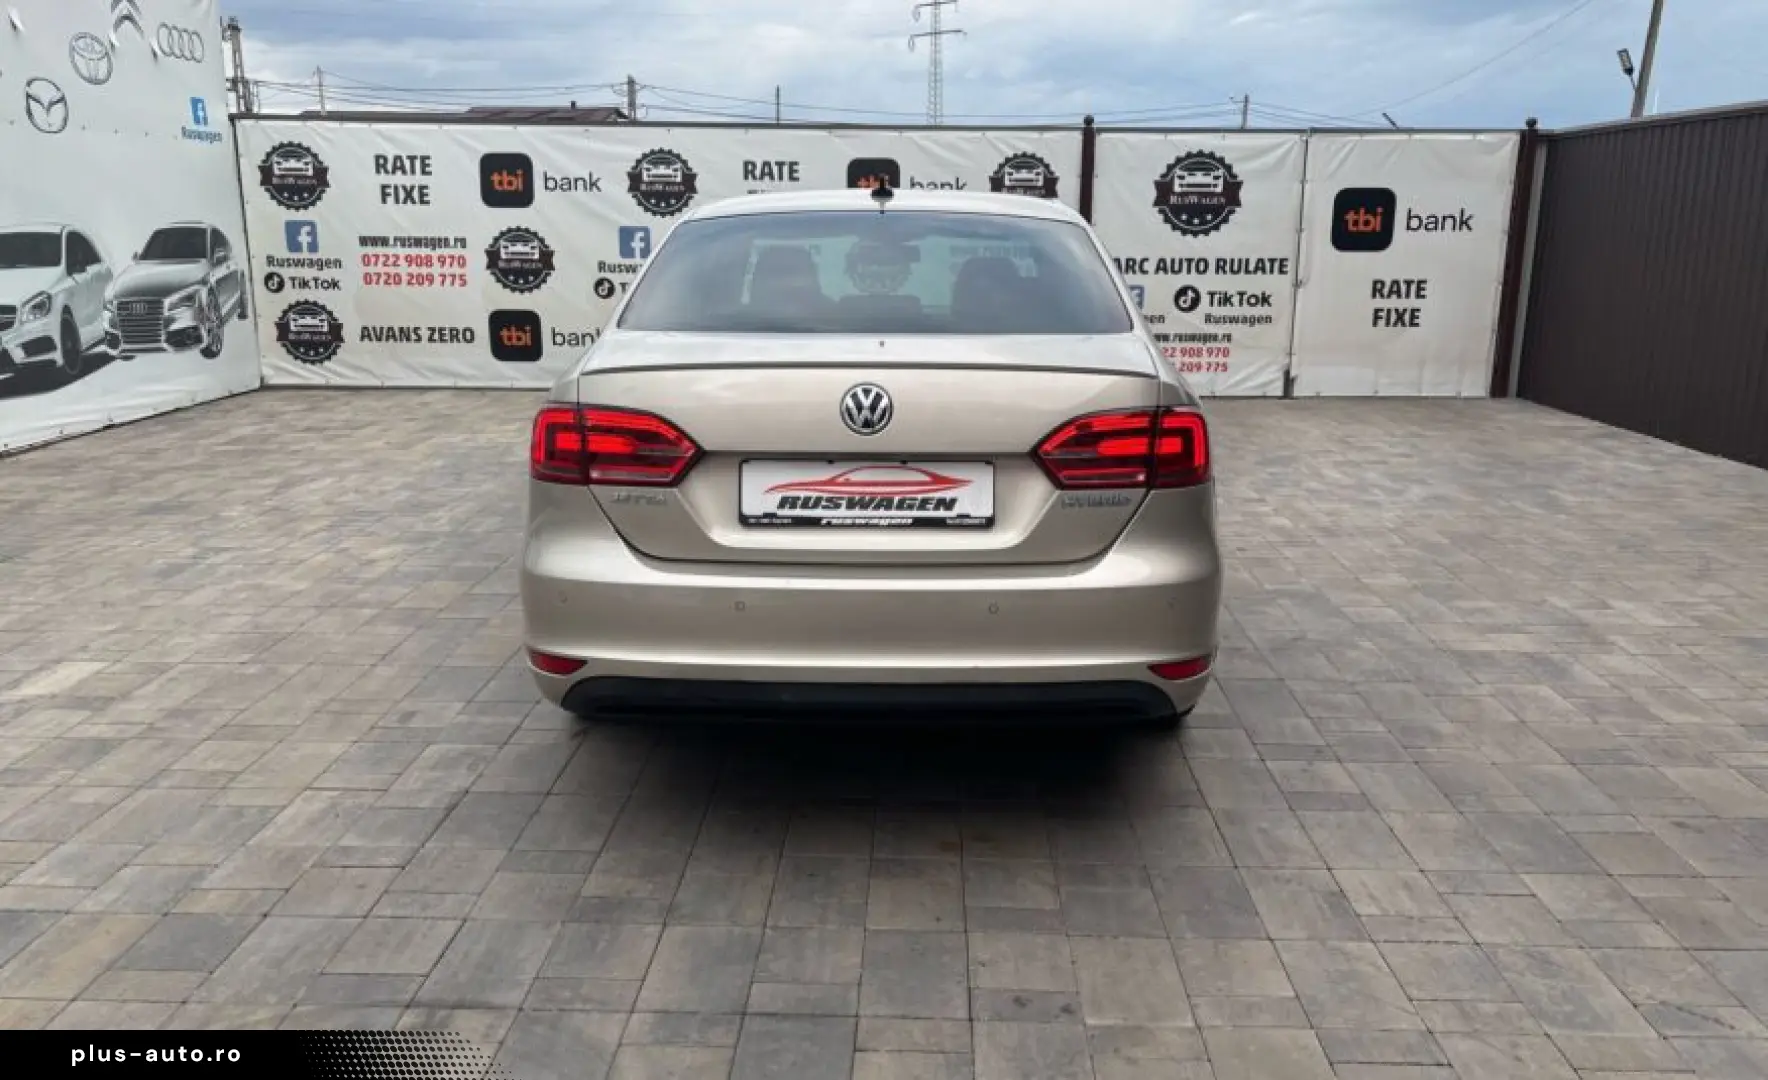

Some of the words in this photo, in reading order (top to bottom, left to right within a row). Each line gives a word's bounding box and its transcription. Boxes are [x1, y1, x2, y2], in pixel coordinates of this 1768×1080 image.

[373, 154, 432, 176] RATE
[743, 160, 800, 182] RATE
[490, 170, 524, 192] tbi
[542, 171, 602, 192] bank
[380, 184, 431, 205] FIXE
[1343, 207, 1383, 232] tbi
[1405, 208, 1474, 232] bank
[266, 255, 342, 271] Ruswagen
[361, 253, 400, 267] 0722
[403, 254, 433, 268] 908
[437, 255, 467, 269] 970
[597, 260, 639, 274] Rusw
[1112, 258, 1149, 275] ARC
[1154, 258, 1209, 275] AUTO
[1214, 258, 1289, 275] RULATE
[288, 276, 341, 291] TikTok
[363, 272, 402, 286] 0720
[406, 273, 434, 287] 209
[438, 274, 468, 288] 775
[1370, 279, 1428, 300] RATE
[1206, 290, 1273, 308] TikTok
[1204, 313, 1273, 327] Ruswagen
[1371, 308, 1422, 328] FIXE
[359, 326, 422, 344] AVANS
[427, 326, 475, 344] ZERO
[500, 324, 533, 346] tbi
[1153, 332, 1232, 345] ww.ruswagen.ro
[1162, 346, 1176, 358] 22
[1178, 346, 1203, 358] 908
[1206, 347, 1230, 359] 970
[1178, 360, 1203, 373] 209
[1205, 361, 1229, 373] 775
[776, 495, 959, 512] RUSWAGEN
